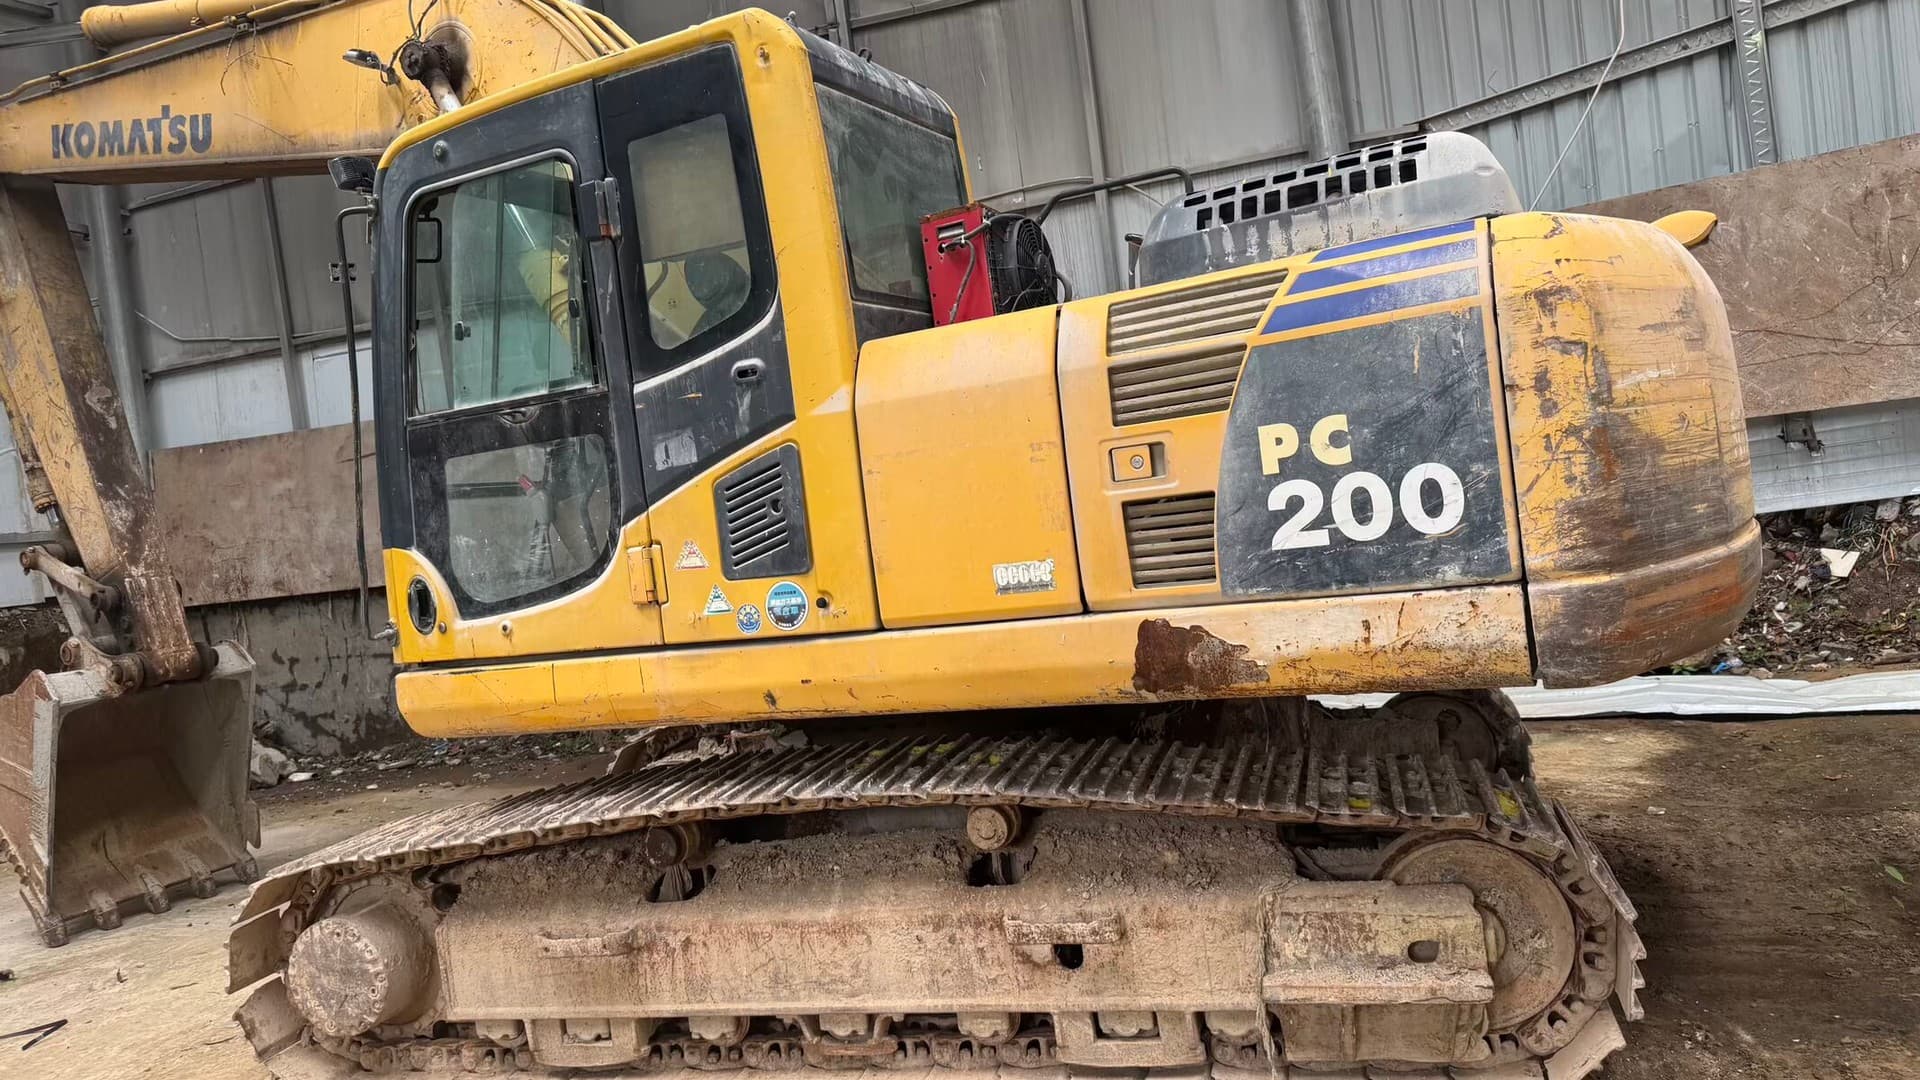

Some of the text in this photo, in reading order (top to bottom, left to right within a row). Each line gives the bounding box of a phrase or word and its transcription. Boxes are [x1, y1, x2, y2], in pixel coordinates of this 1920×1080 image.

[51, 104, 212, 159] KOMATSU
[1257, 413, 1353, 476] PC
[1267, 462, 1465, 551] 200
